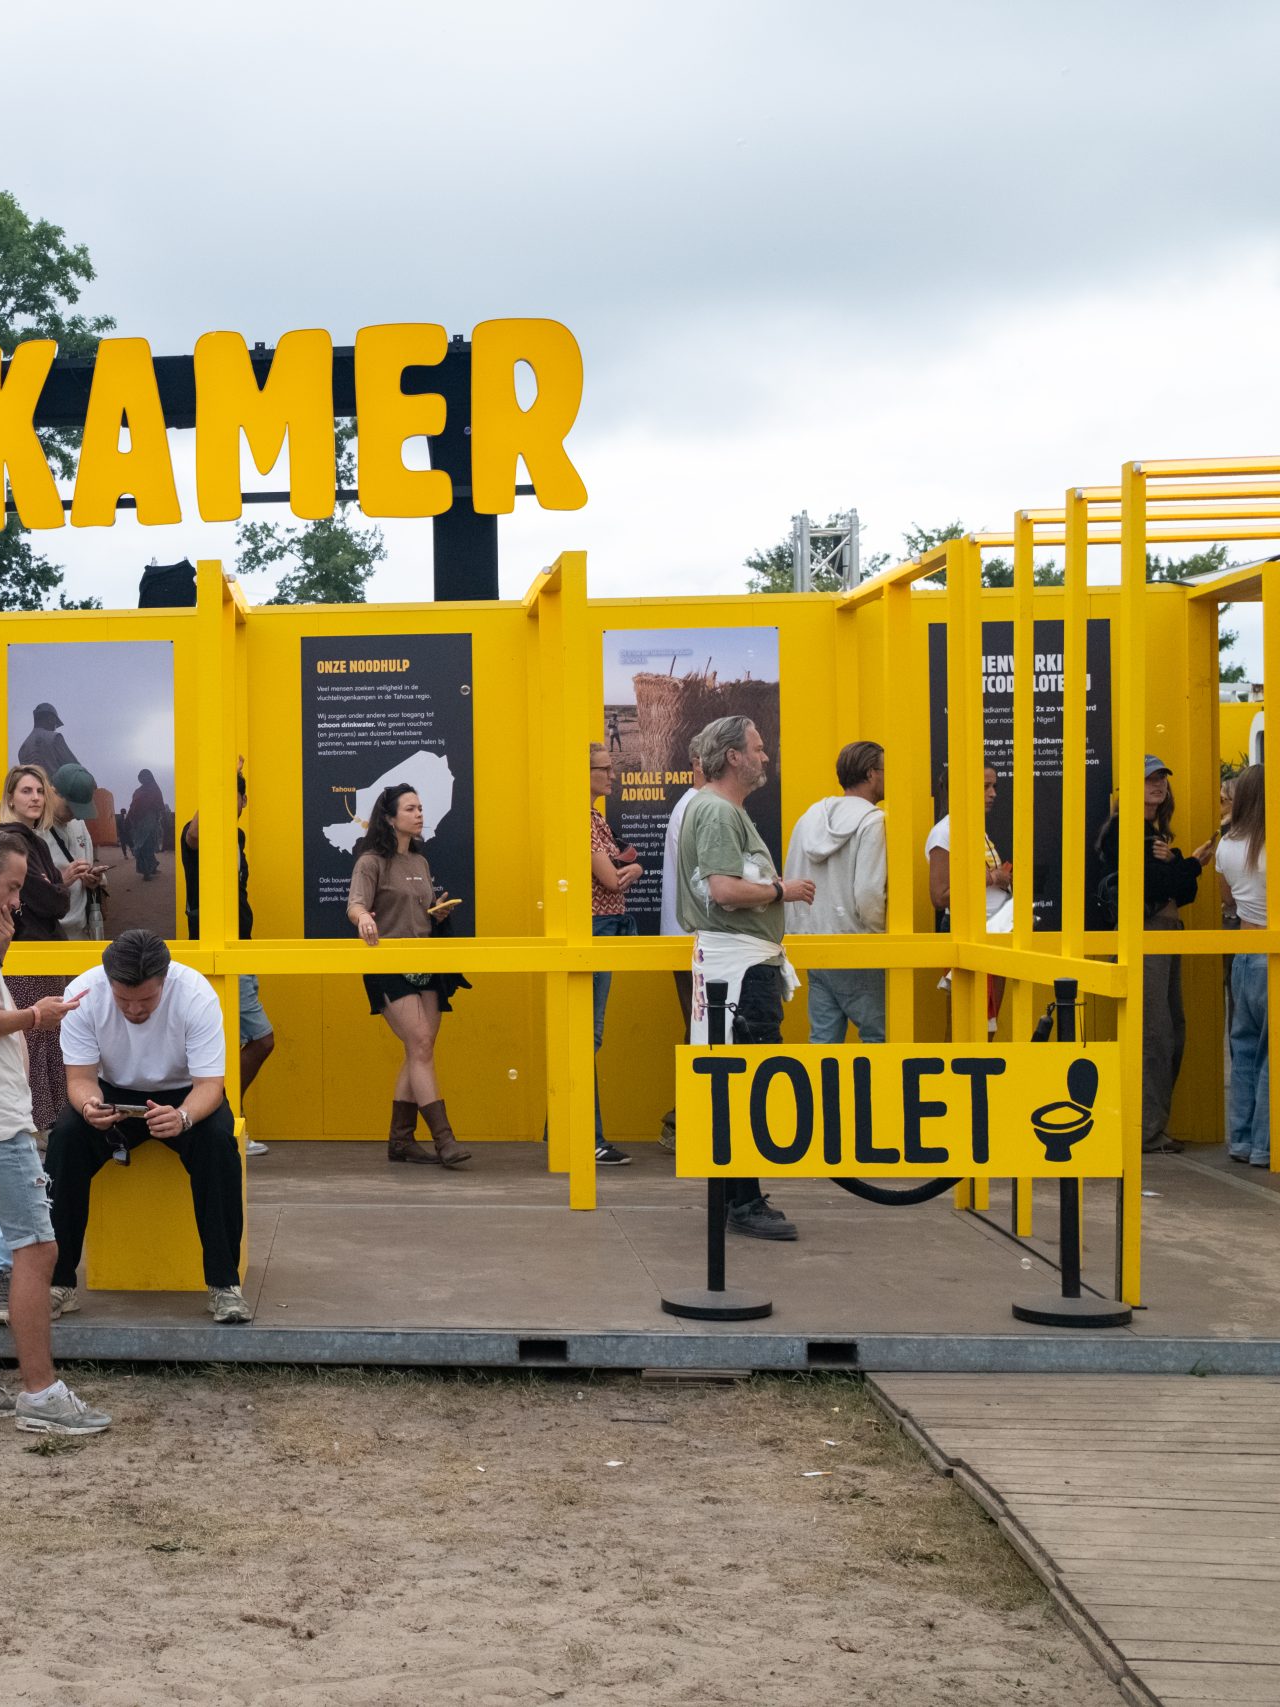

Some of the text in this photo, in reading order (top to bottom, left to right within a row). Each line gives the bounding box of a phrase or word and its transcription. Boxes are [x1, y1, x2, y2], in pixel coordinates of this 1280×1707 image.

[317, 659, 410, 674] ONZE NOODHULP
[376, 684, 402, 692] veiligheid
[317, 694, 376, 702] vluchtelingenkampen
[1037, 716, 1056, 725] Niger!
[328, 731, 356, 739] jerrycans)
[317, 740, 345, 748] gezinnen,
[621, 771, 694, 785] LOKALE PART
[621, 787, 666, 801] ADKOUL
[692, 1056, 1007, 1166] TOILET
